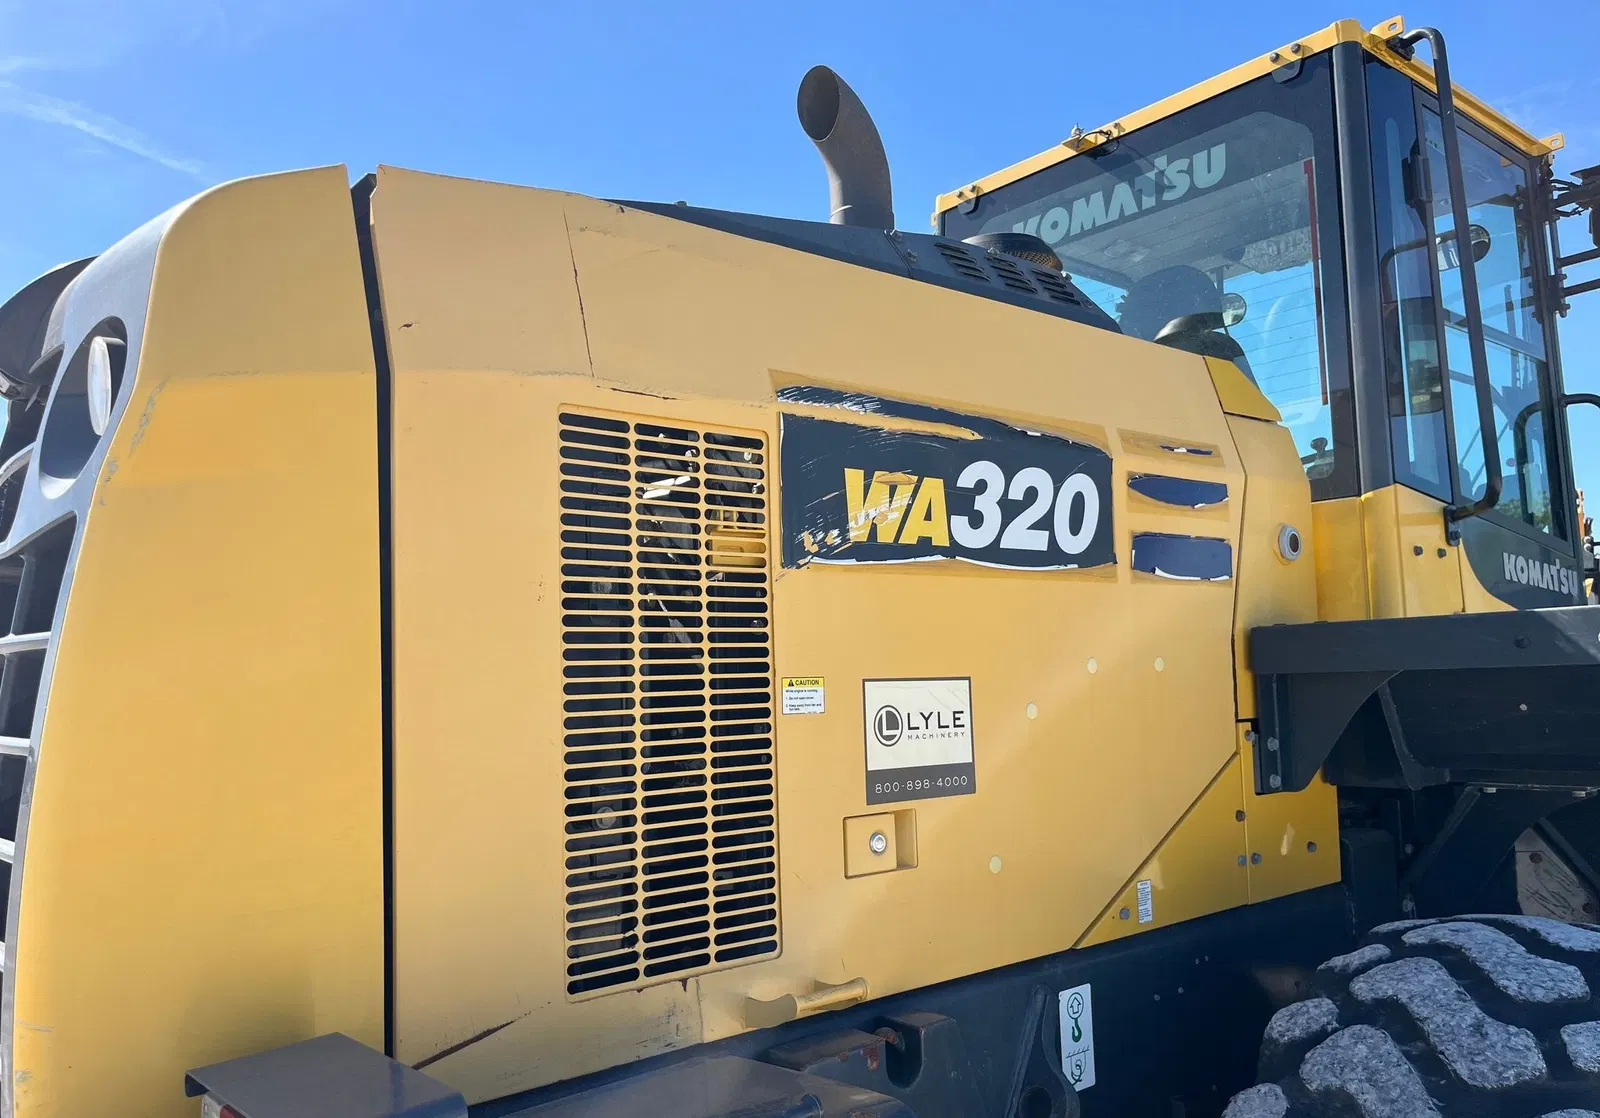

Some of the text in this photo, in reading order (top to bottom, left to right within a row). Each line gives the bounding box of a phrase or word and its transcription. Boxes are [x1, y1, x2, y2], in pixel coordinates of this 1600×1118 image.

[843, 460, 1100, 555] WA320
[1502, 552, 1578, 597] KOMATSU
[907, 710, 965, 730] LYLE
[907, 731, 966, 740] MACHINERY
[875, 775, 968, 794] 800-898-4000
